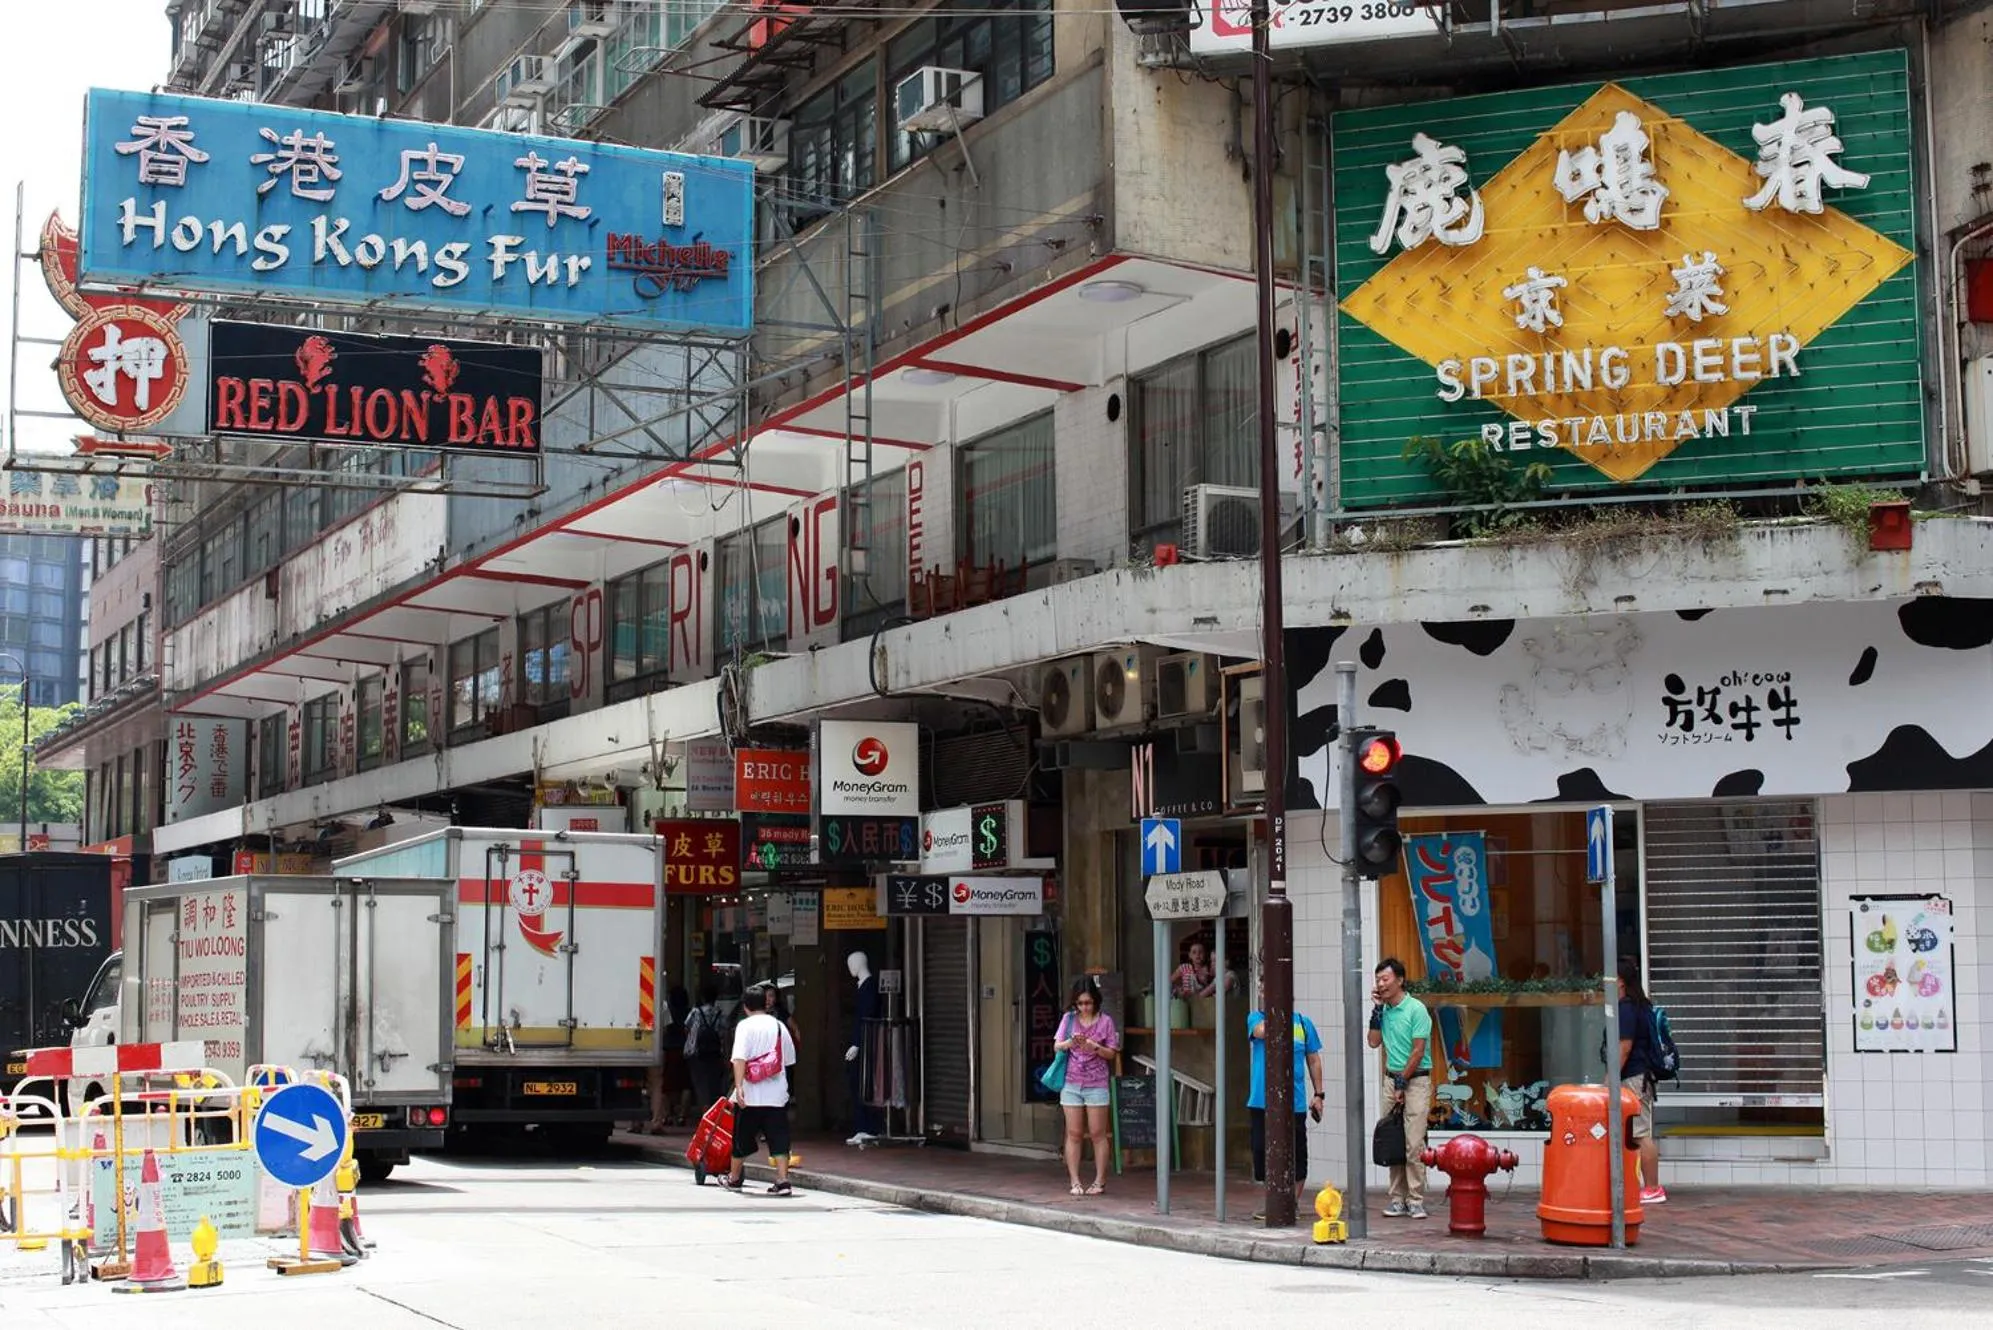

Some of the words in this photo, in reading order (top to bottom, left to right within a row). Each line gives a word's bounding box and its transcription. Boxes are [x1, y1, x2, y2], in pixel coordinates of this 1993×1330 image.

[1299, 6, 1354, 26] 2739
[115, 115, 593, 228] 香港皮草
[118, 197, 290, 272] Hong
[312, 214, 471, 288] Kong
[485, 233, 592, 287] Fur
[607, 232, 729, 270] Michelle
[1503, 250, 1730, 333] 京菜
[84, 322, 169, 413] 押
[1435, 346, 1630, 403] SPRING
[1655, 332, 1802, 387] DEER
[215, 376, 305, 433] RED
[323, 384, 433, 442] LION
[447, 396, 536, 449] BAR
[1480, 404, 1758, 452] RESTAURANT
[1657, 732, 1733, 746] ソフトクリーム
[176, 721, 199, 805] 北京ダック
[209, 722, 230, 799] 香港で一番
[743, 761, 792, 781] ERIC
[832, 780, 909, 795] MoneyGram
[843, 795, 867, 804] money
[867, 795, 898, 803] transfer
[1200, 800, 1214, 811] CO
[671, 831, 726, 859] 皮草
[932, 832, 970, 849] MoneyGram
[980, 814, 998, 859] $
[664, 864, 735, 886] FURS
[1186, 878, 1205, 890] Road
[970, 889, 1038, 902] MoneyGram
[181, 938, 194, 961] TIU
[194, 937, 211, 958] WO
[211, 935, 245, 958] LOONG
[180, 973, 211, 989] IMPORTED
[217, 970, 245, 986] CHILLED
[180, 992, 209, 1010] POULTRY
[211, 992, 237, 1008] SUPPLY
[525, 1083, 542, 1094] NL
[546, 1083, 575, 1094] 2932
[186, 1170, 212, 1183] 2824
[217, 1169, 242, 1181] 5000
